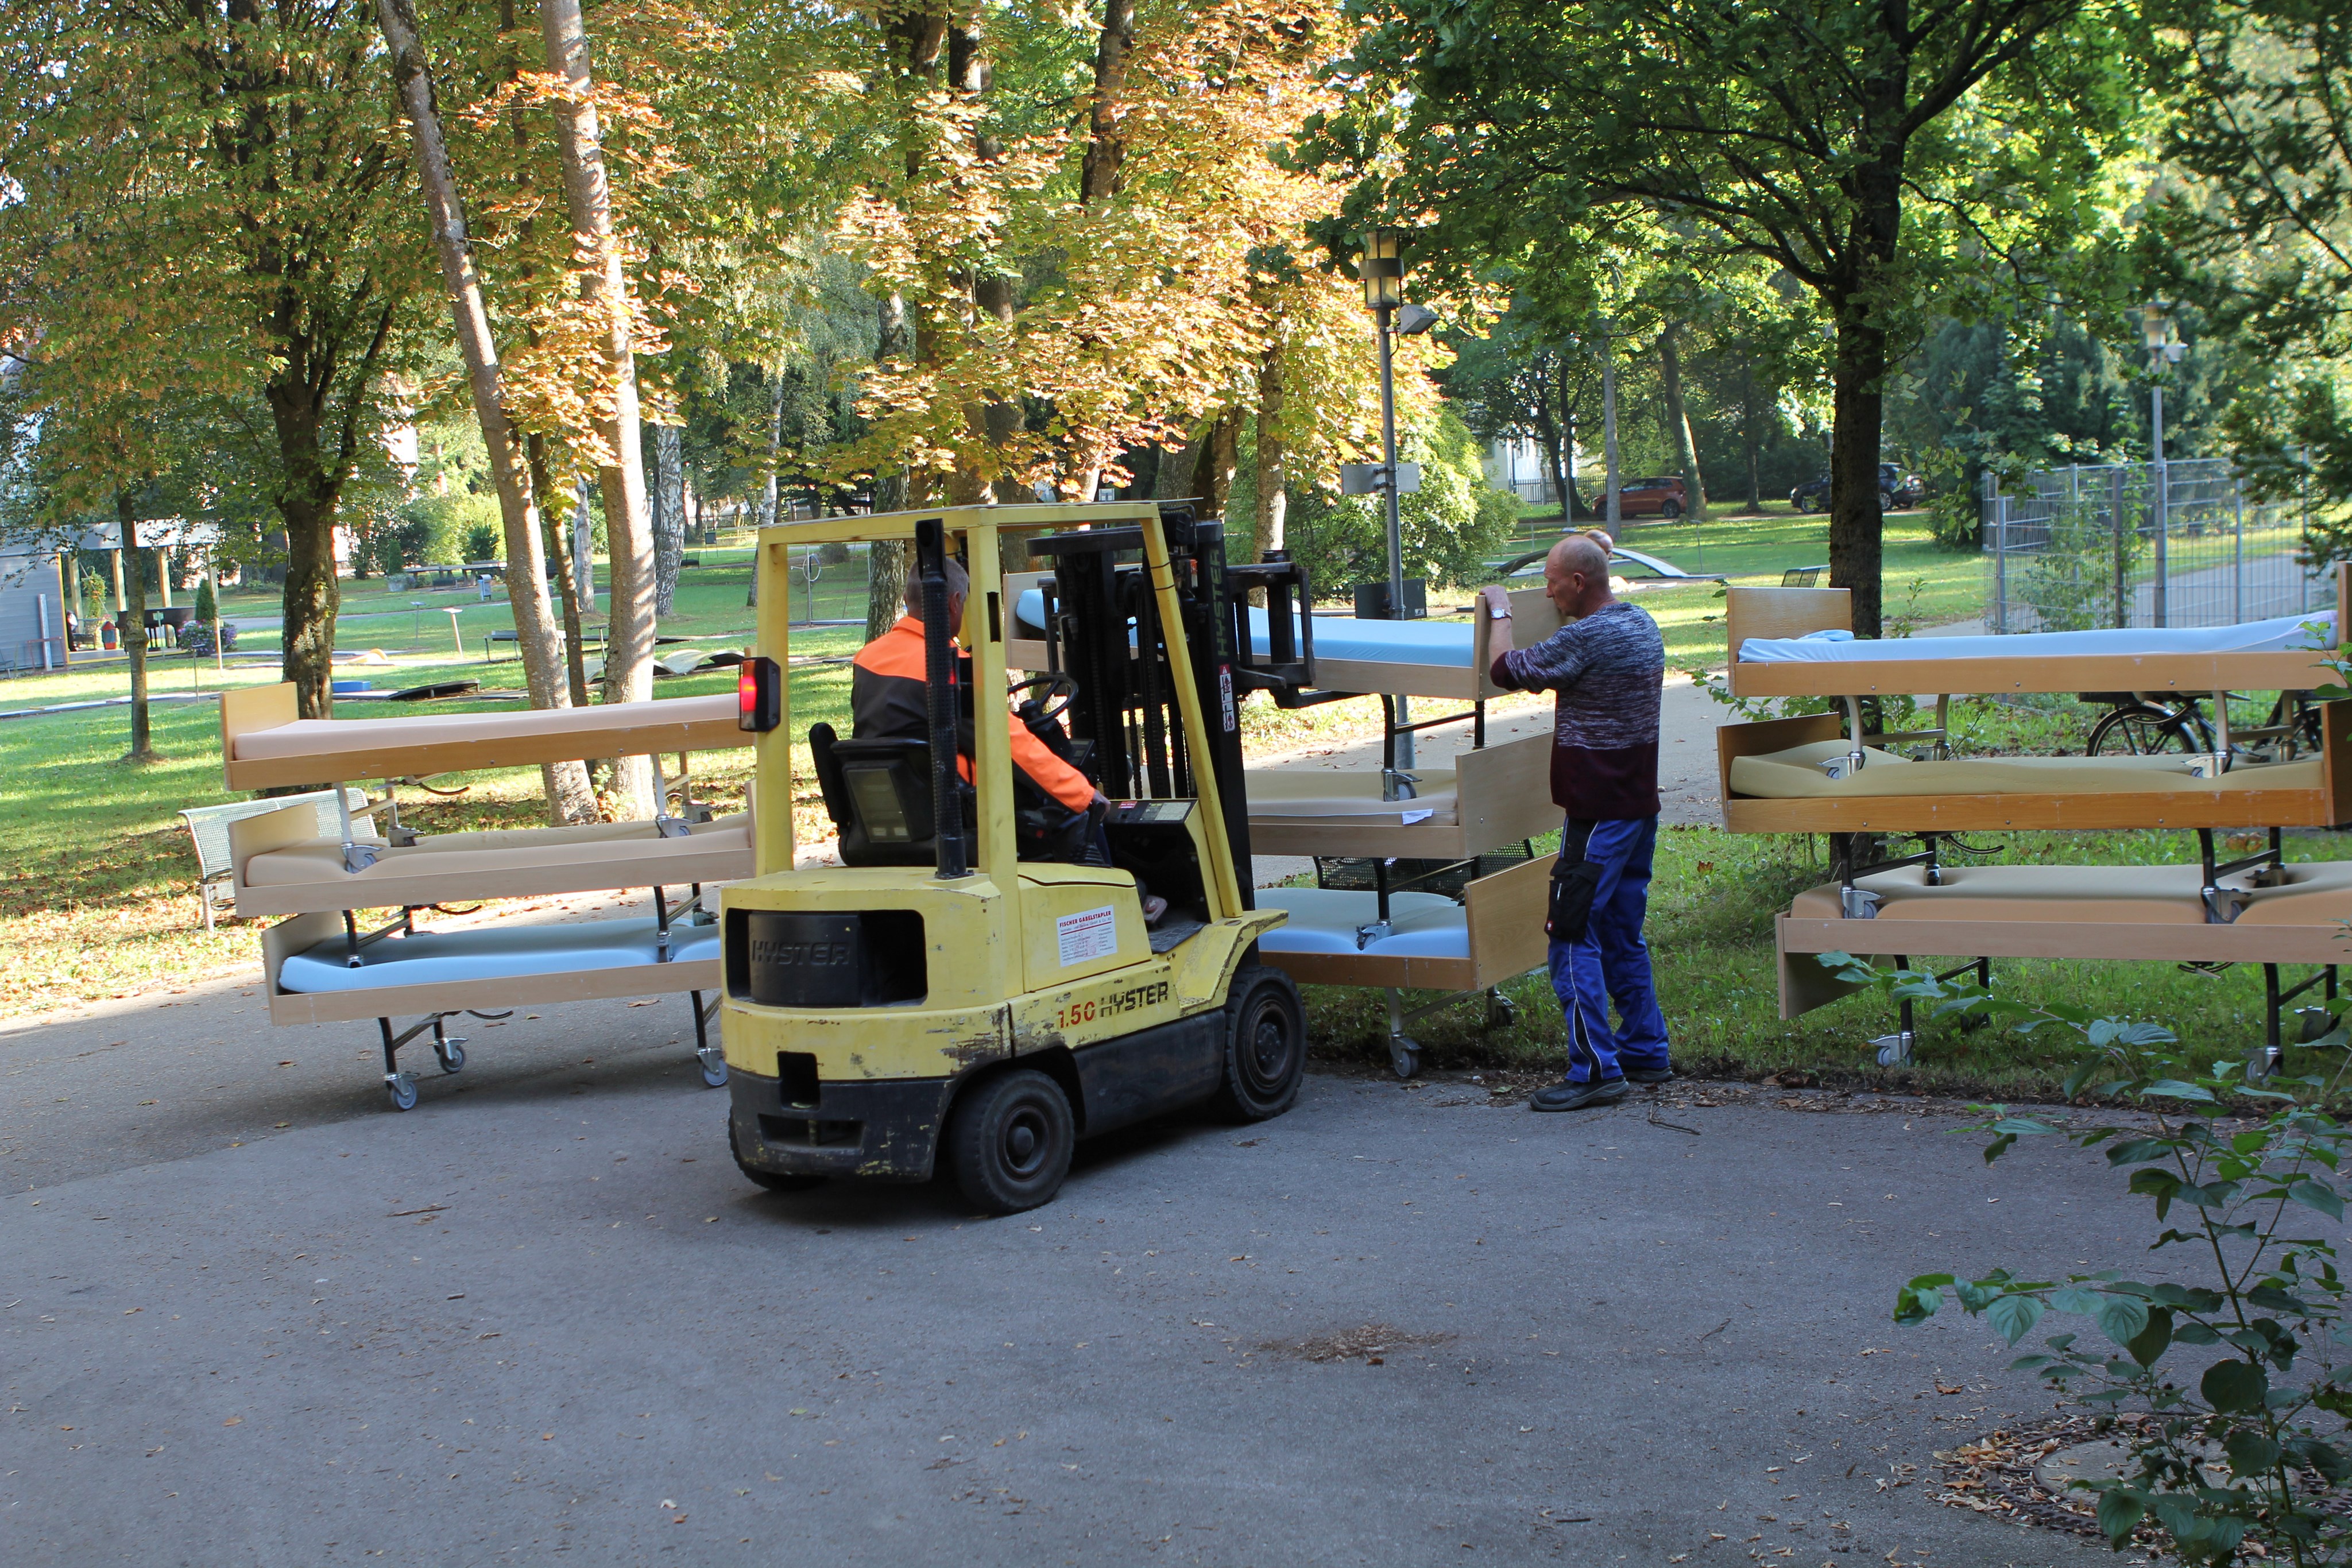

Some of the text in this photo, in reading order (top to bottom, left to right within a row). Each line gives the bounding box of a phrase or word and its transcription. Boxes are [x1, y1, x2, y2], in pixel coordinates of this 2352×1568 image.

[1209, 548, 1228, 656] HYSTER
[1059, 911, 1111, 928] FISCHER GABELSTAPLER
[752, 940, 850, 965] HYSTER
[1058, 981, 1169, 1028] 1.50 HYSTER
